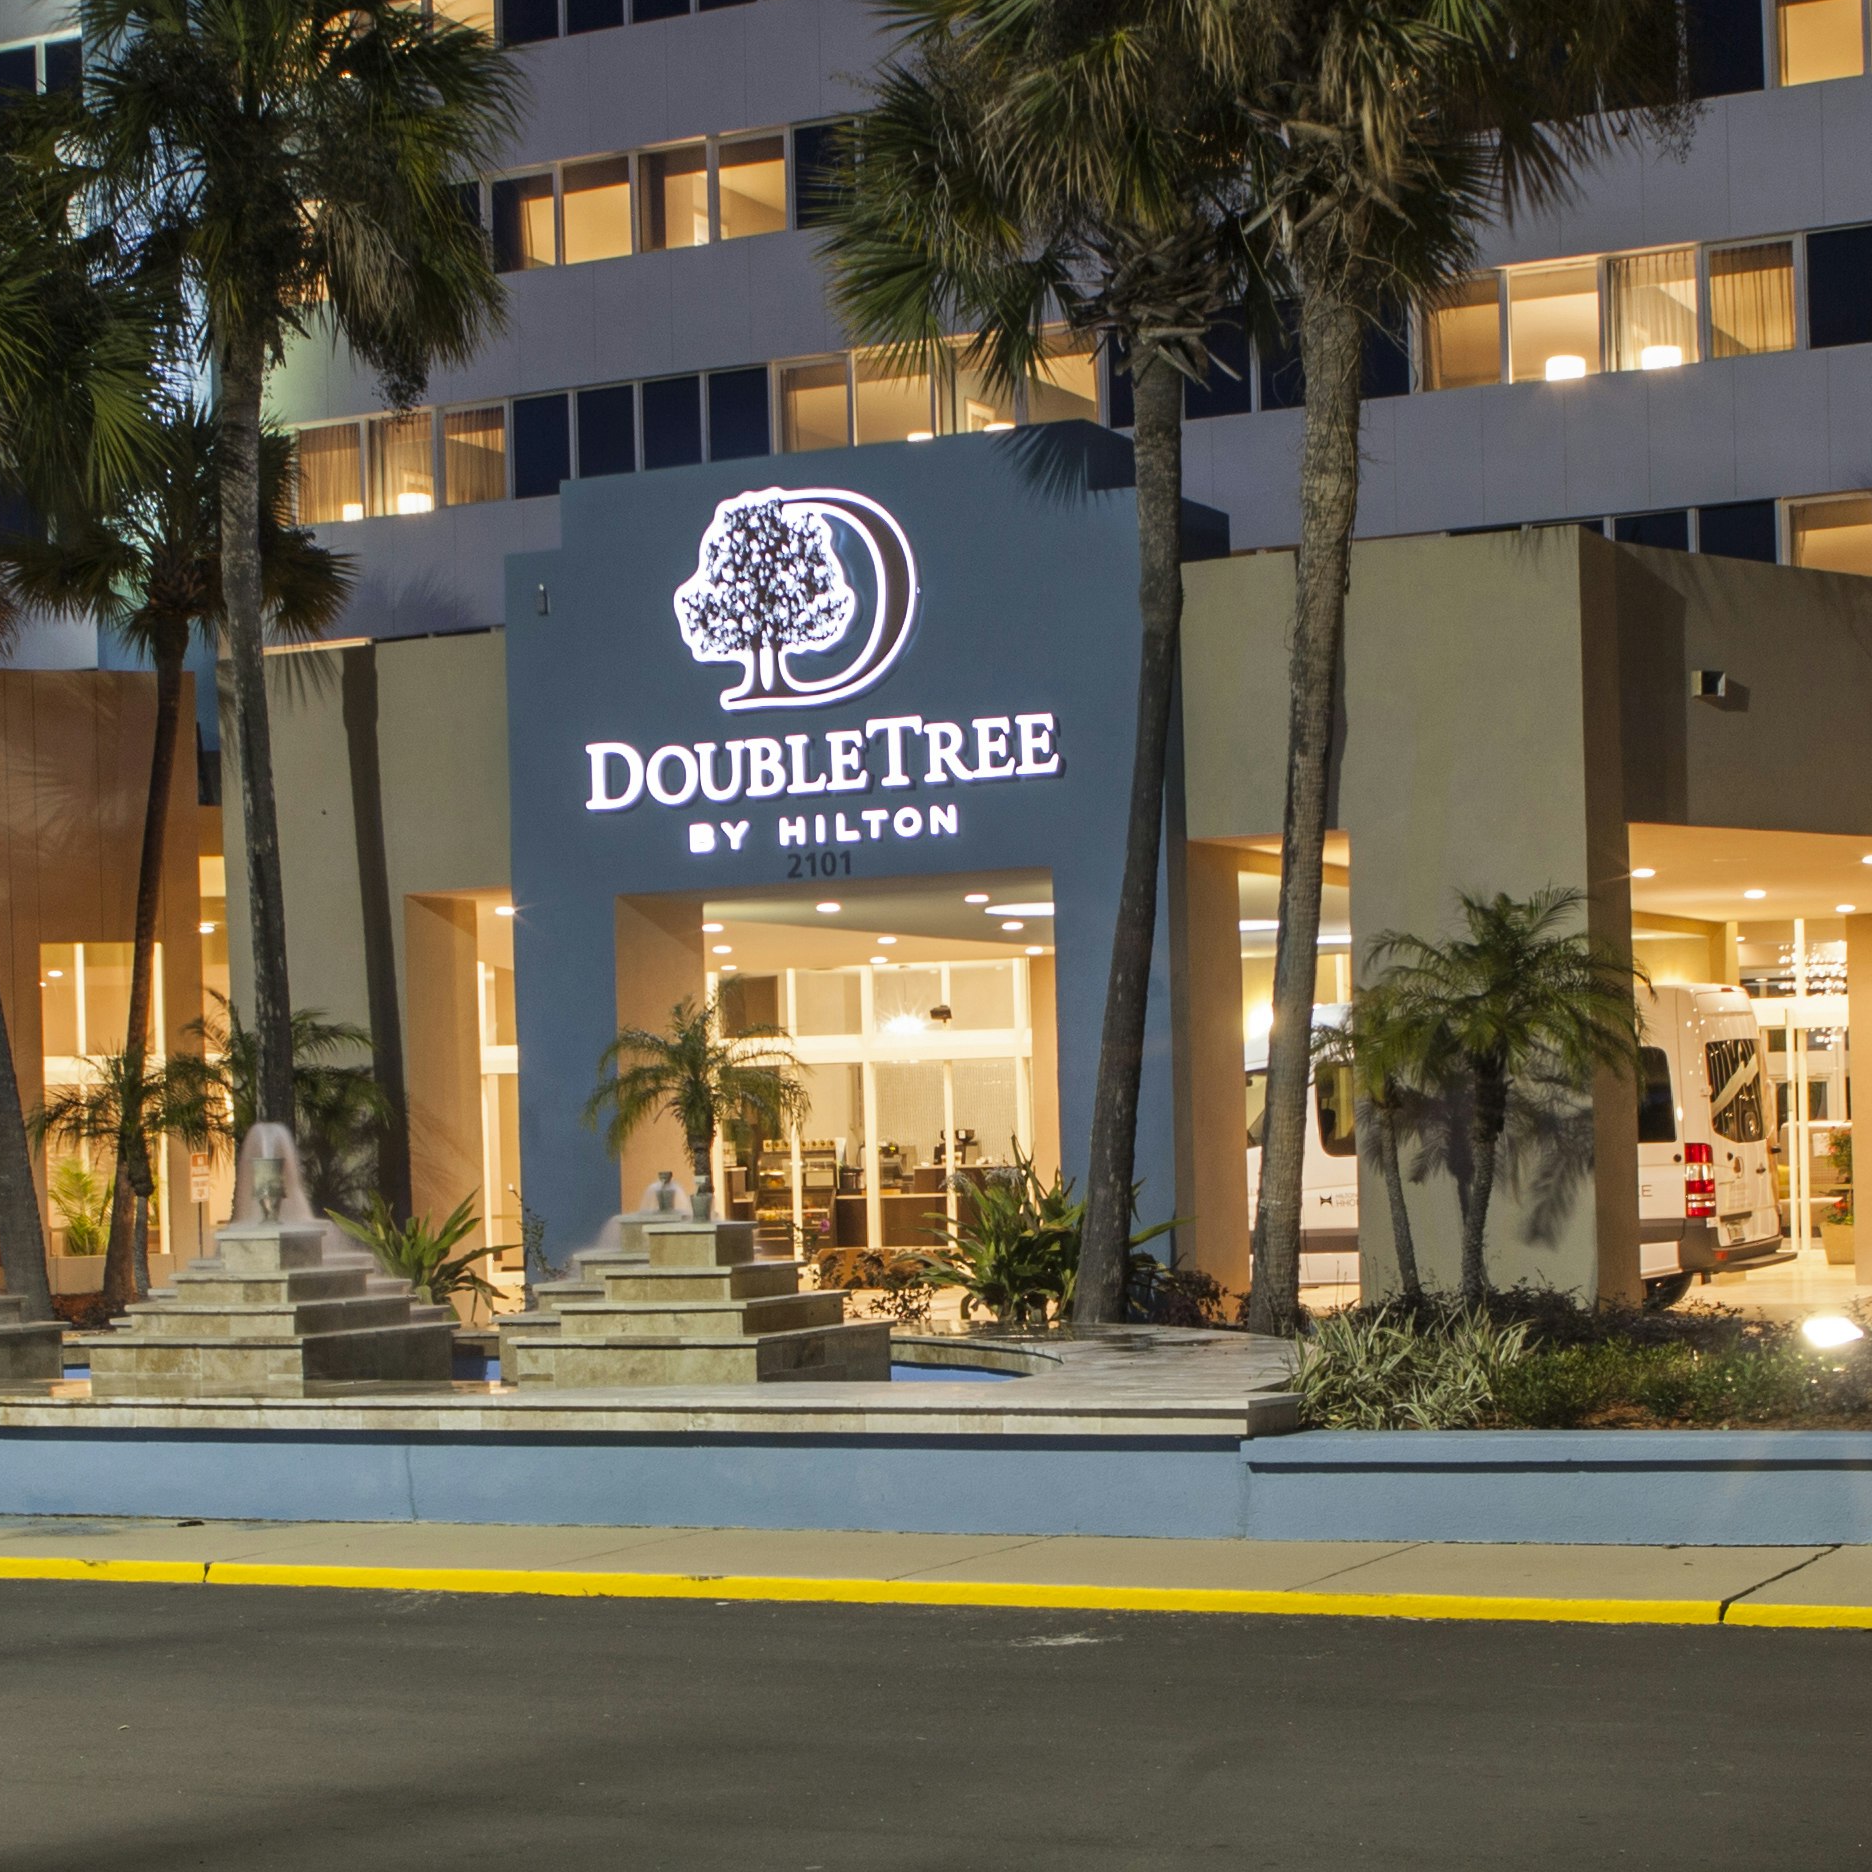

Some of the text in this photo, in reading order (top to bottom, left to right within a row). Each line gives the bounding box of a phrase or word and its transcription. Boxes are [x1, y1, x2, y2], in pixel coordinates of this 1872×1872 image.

[584, 712, 1060, 811] DOUBLETREE
[688, 804, 959, 854] BY HILTON
[786, 850, 853, 879] 2101
